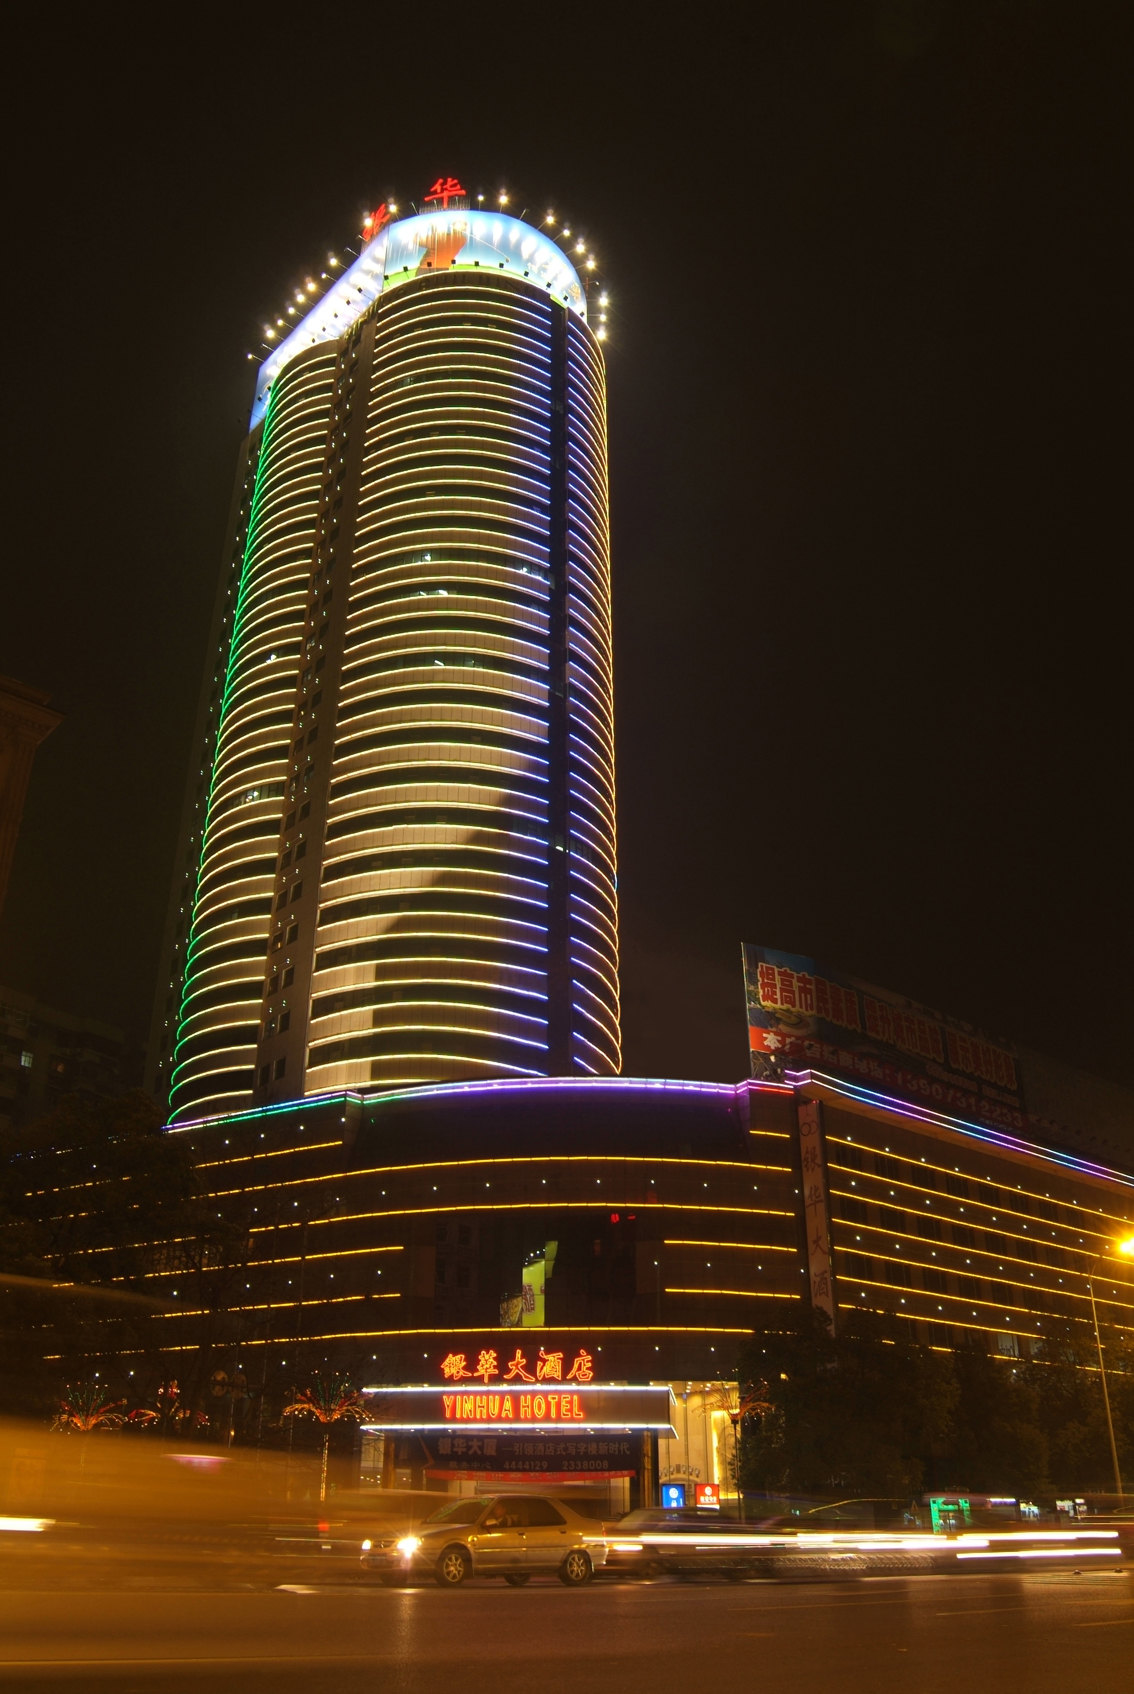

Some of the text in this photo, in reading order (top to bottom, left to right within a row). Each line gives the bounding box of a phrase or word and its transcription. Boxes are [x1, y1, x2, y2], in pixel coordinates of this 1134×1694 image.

[424, 177, 466, 209] 华
[442, 1393, 583, 1418] YINHUA HOTEL
[503, 1460, 549, 1470] 4444129
[562, 1460, 609, 1470] 2338008
